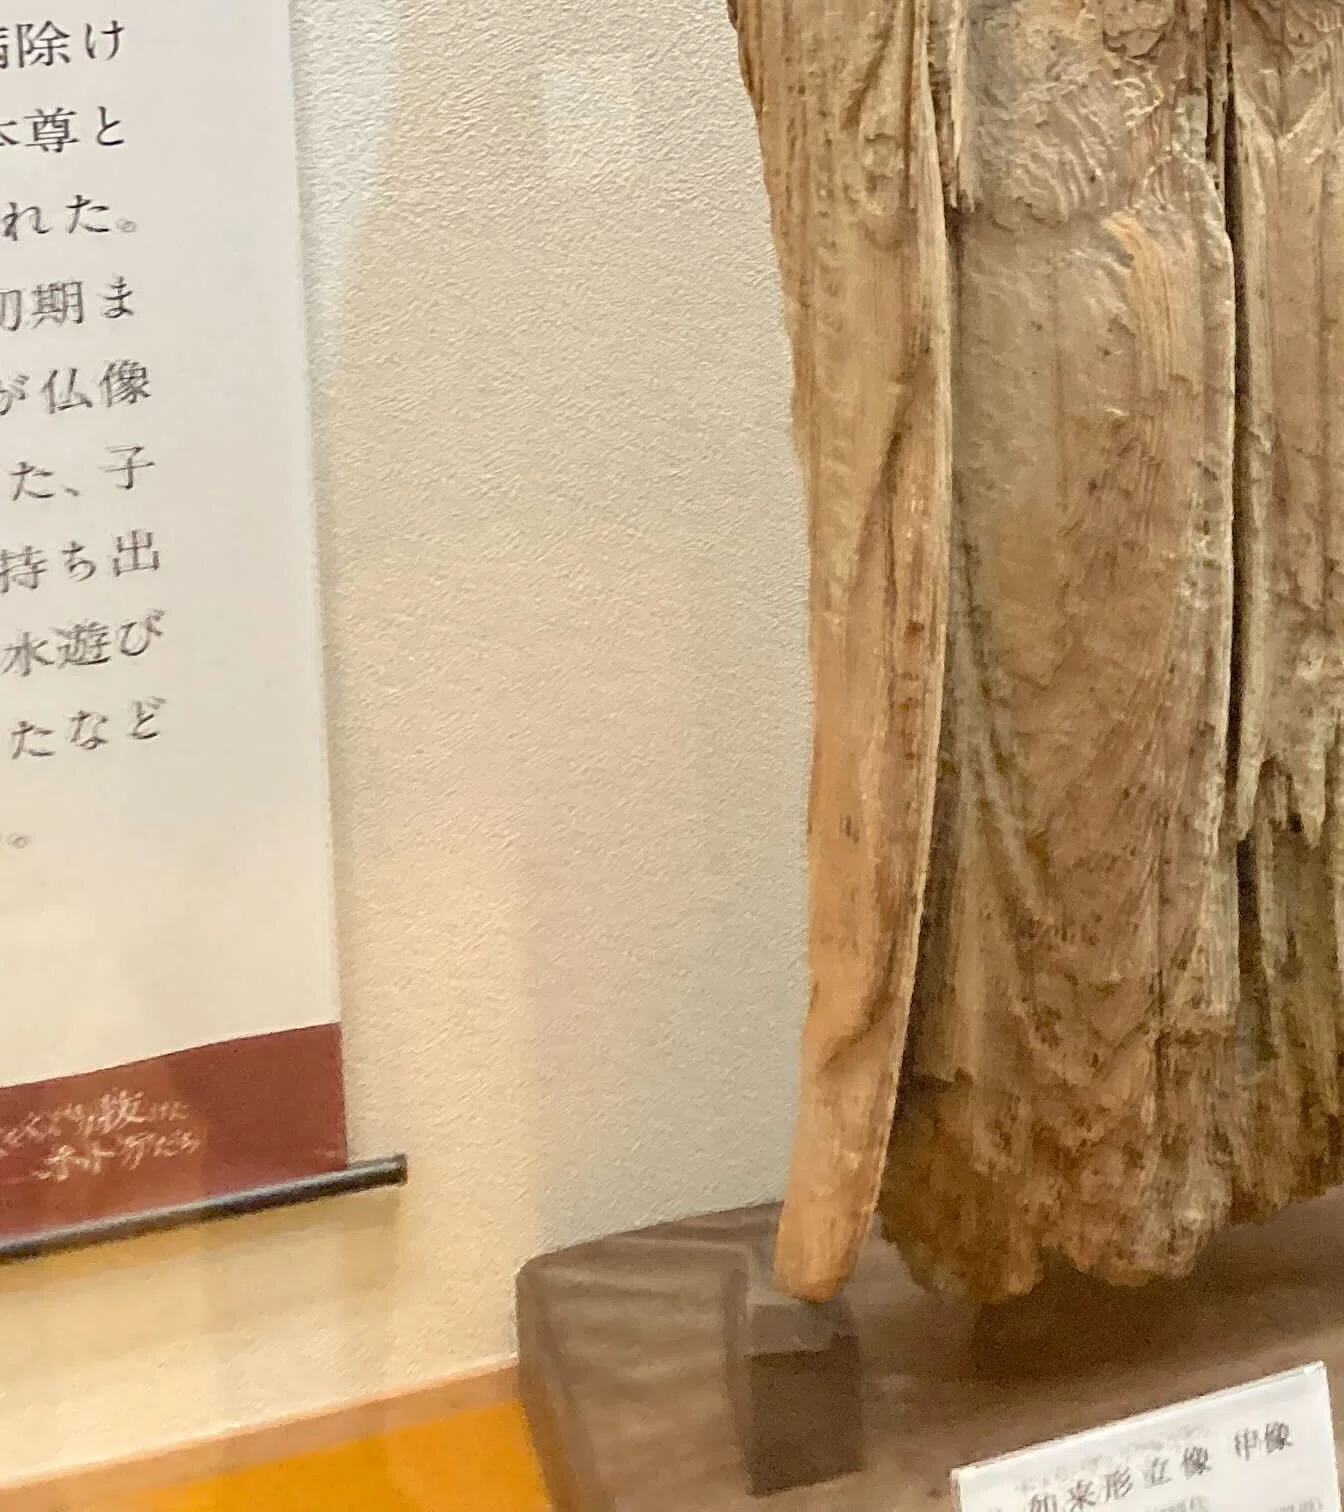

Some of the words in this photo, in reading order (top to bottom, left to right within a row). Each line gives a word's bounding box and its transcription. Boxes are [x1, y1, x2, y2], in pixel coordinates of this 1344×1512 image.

[0, 19, 125, 69] 除け
[1, 194, 137, 241] れた。
[10, 445, 155, 501] た、子
[0, 609, 165, 677] 水遊び
[11, 697, 166, 760] たなど
